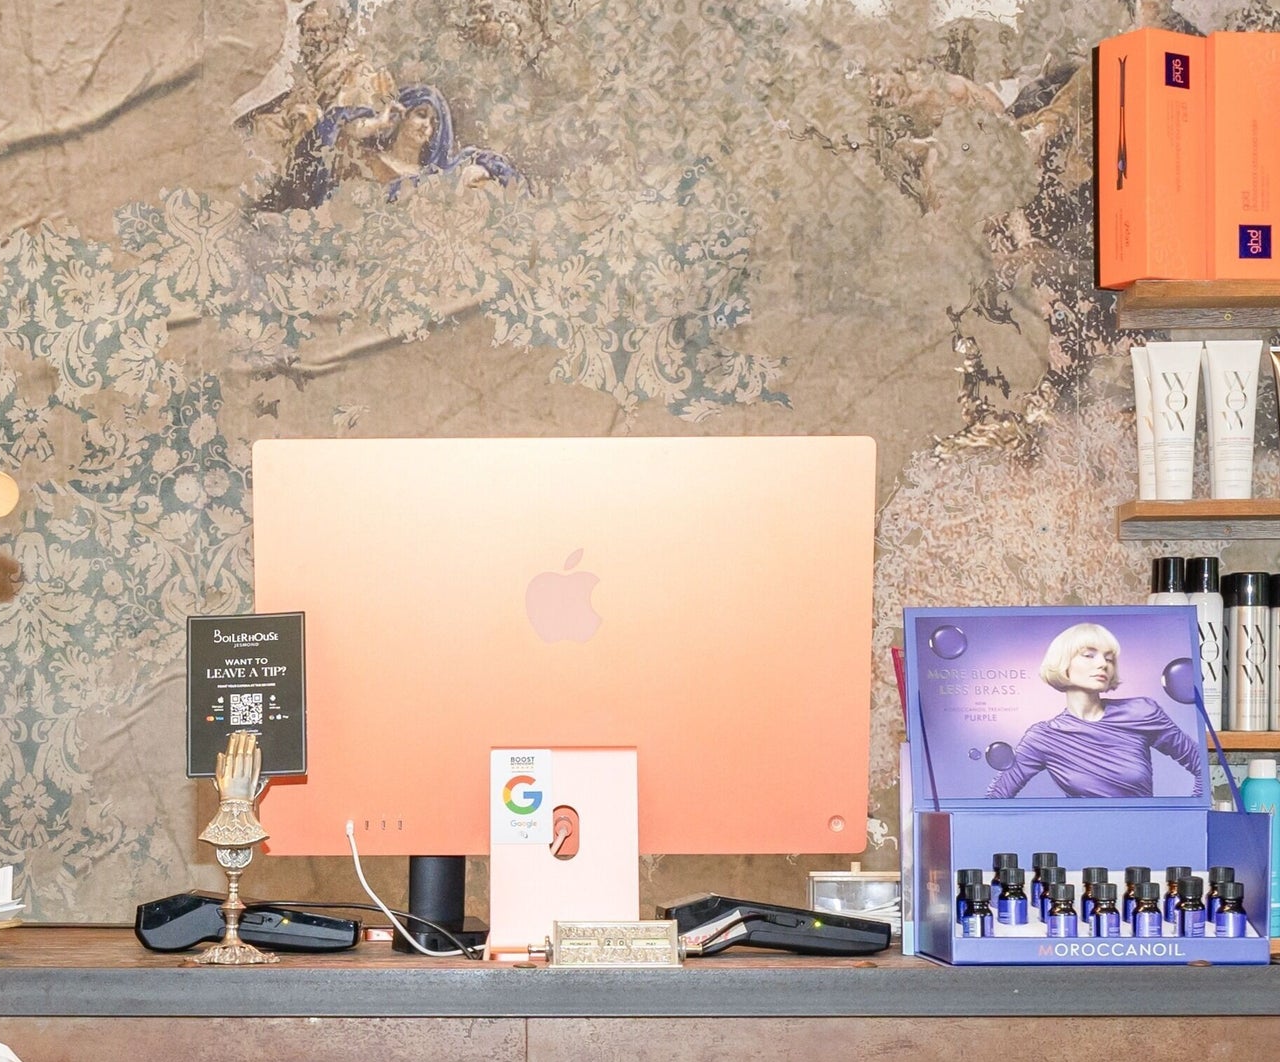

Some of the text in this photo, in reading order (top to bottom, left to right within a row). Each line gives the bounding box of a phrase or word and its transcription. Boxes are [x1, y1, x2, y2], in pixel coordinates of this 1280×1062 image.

[1173, 59, 1184, 83] ghd
[1248, 230, 1262, 254] ghd
[225, 658, 253, 666] WANT
[206, 666, 287, 679] LEAVE A TIP?
[928, 669, 1031, 680] MORE BLONDE.
[939, 685, 1020, 695] LESS BRASS.
